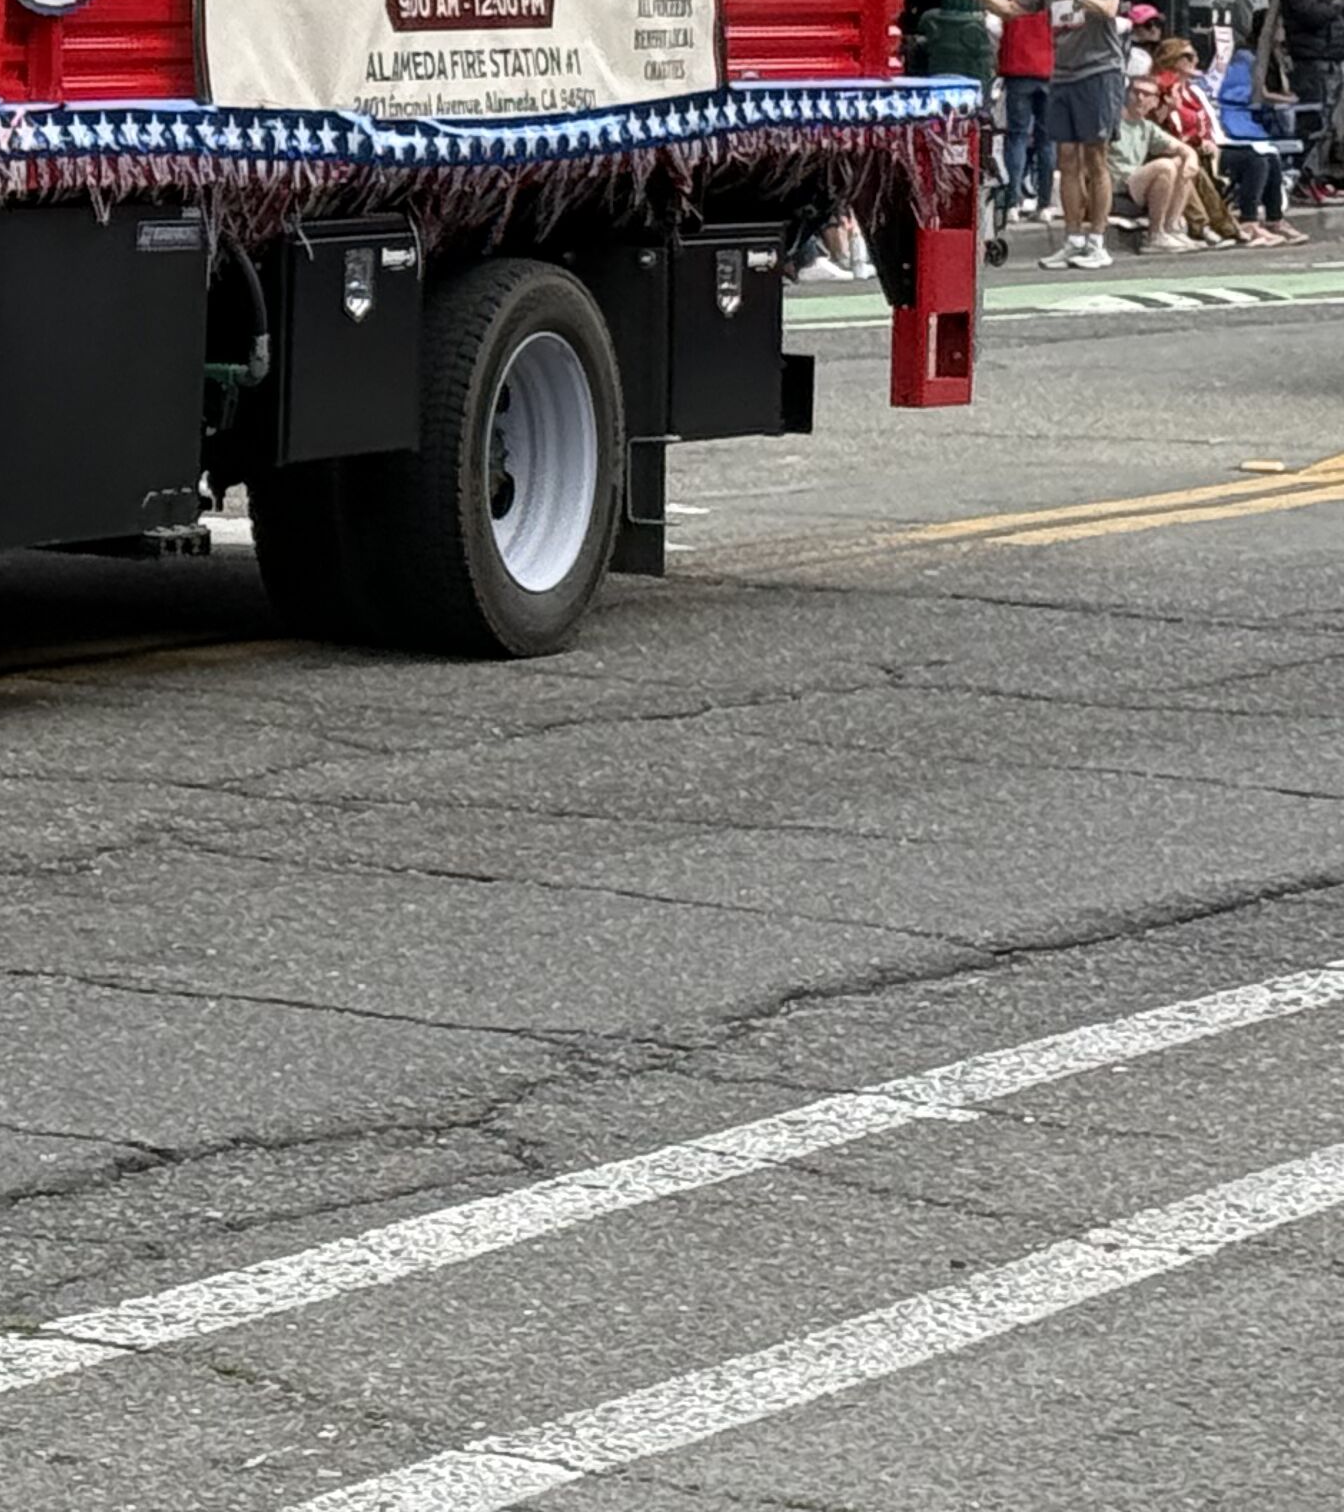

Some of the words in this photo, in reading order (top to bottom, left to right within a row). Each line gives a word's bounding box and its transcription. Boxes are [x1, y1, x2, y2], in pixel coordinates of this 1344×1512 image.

[366, 49, 448, 82] ALAMEDA
[450, 49, 486, 79] FIRE
[489, 48, 561, 78] STATION
[541, 90, 558, 111] CA
